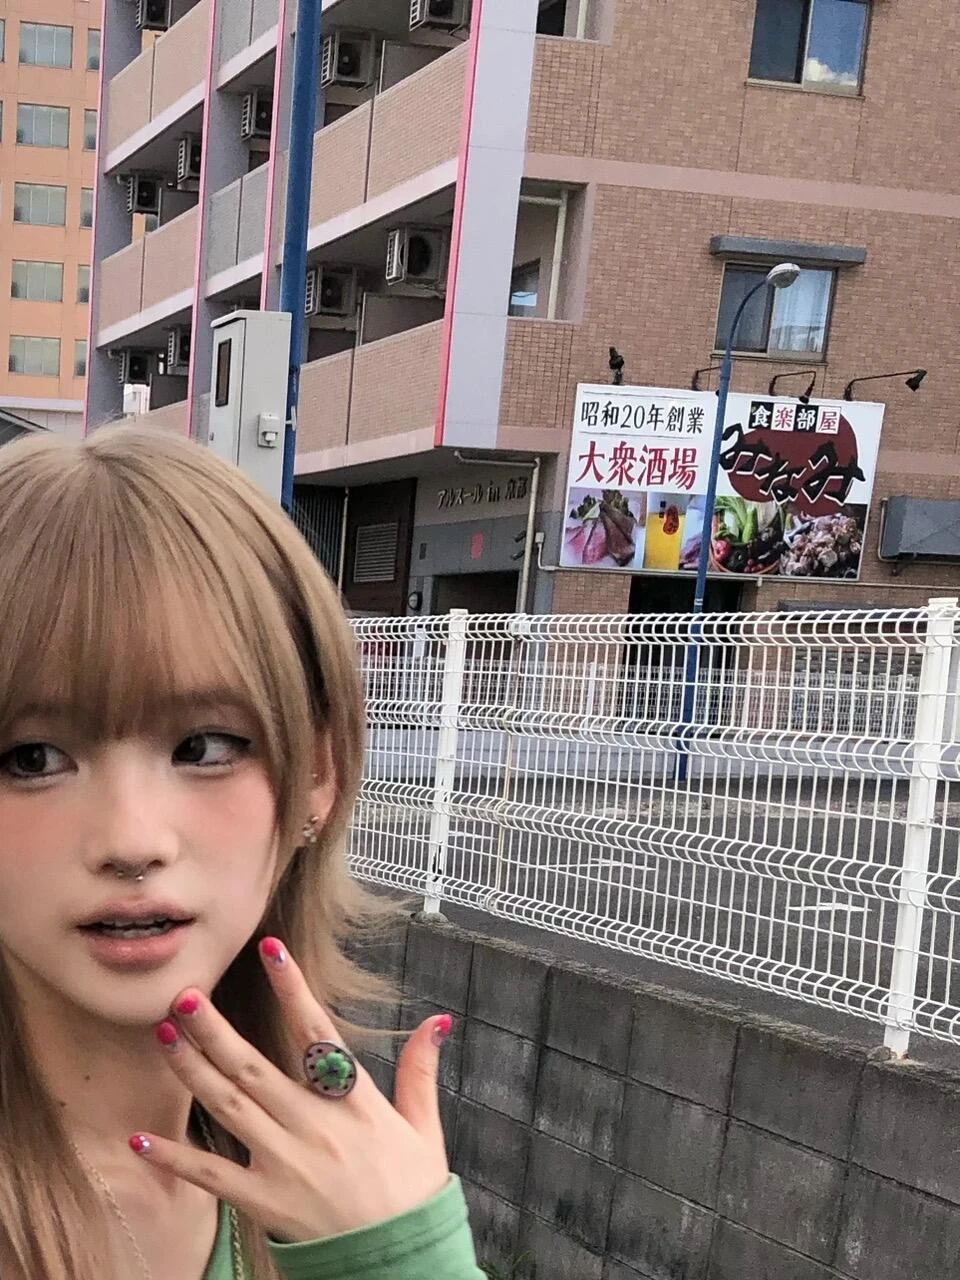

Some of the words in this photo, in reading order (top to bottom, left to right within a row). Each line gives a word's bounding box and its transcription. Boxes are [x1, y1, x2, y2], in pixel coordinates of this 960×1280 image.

[581, 400, 706, 434] 昭和20年創業
[751, 404, 838, 432] 食楽部屋
[575, 440, 699, 491] 大衆酒場
